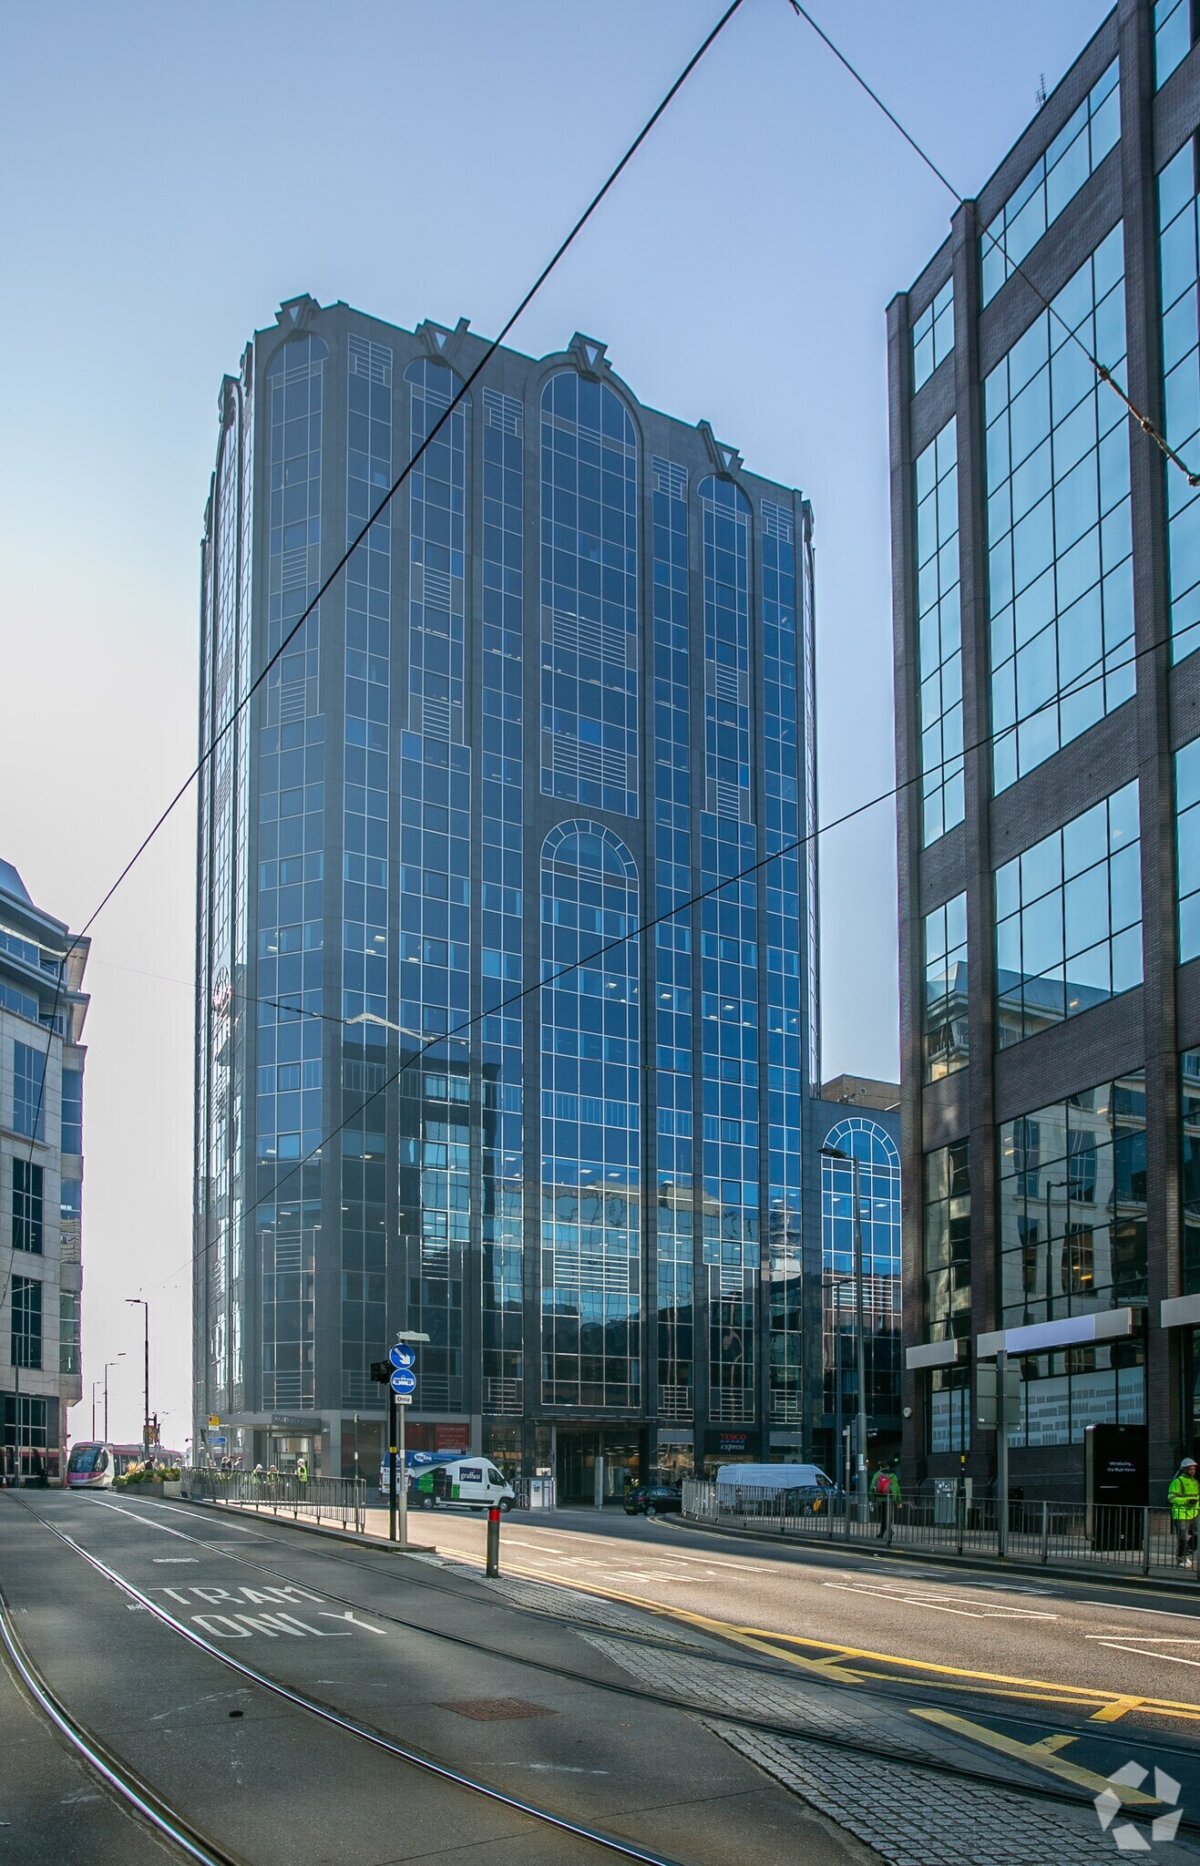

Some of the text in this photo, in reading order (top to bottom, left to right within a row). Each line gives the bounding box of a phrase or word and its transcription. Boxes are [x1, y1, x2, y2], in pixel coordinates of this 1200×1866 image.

[720, 1432, 747, 1440] TESCO
[148, 1586, 326, 1604] TRAM
[191, 1612, 387, 1638] ONLY
